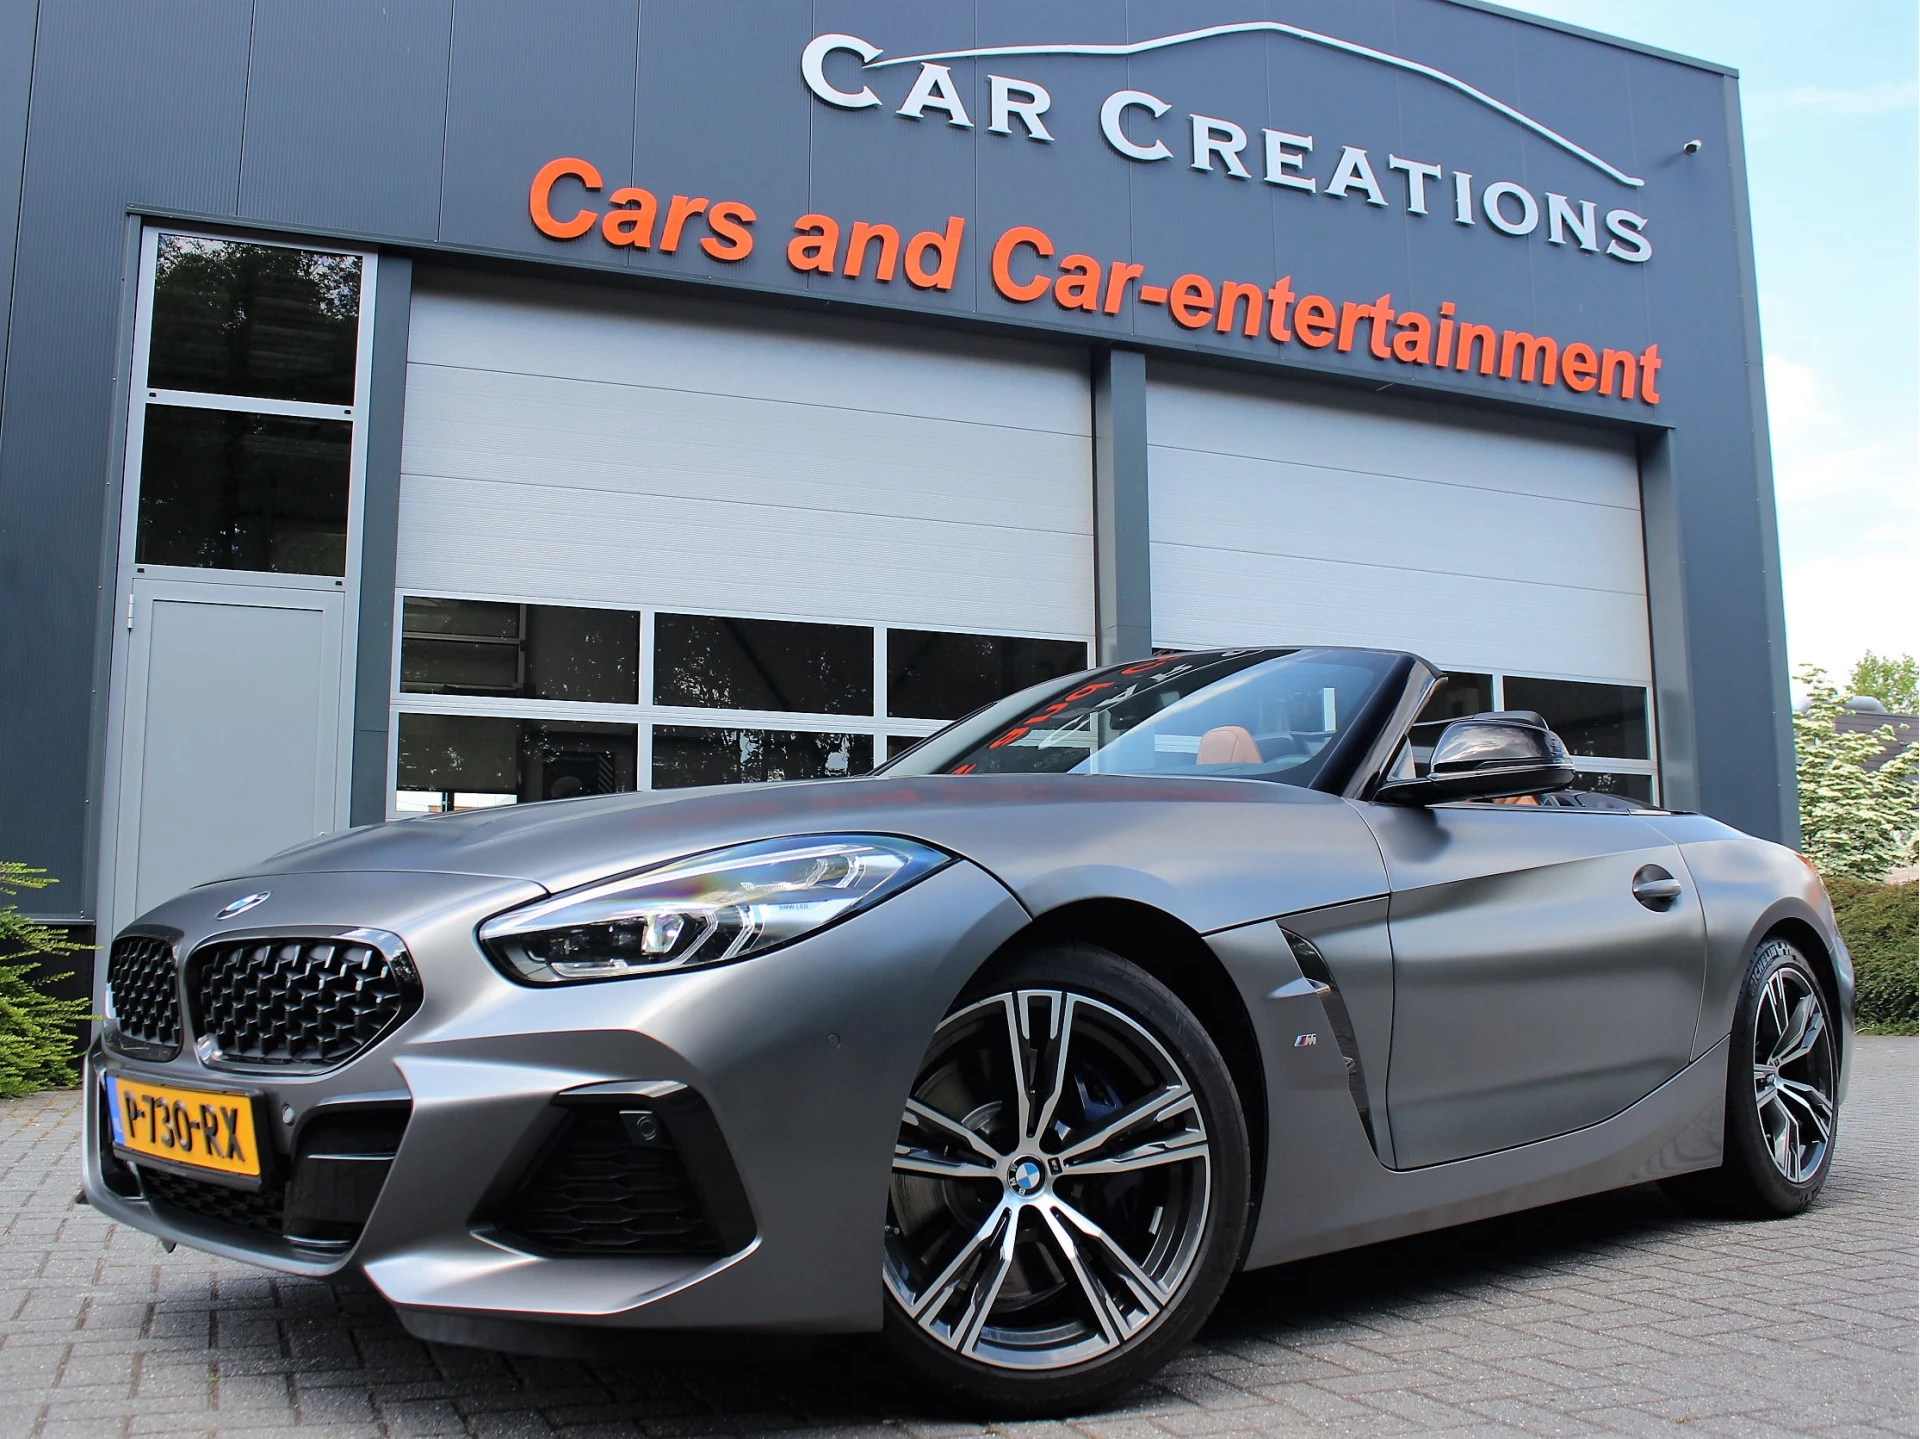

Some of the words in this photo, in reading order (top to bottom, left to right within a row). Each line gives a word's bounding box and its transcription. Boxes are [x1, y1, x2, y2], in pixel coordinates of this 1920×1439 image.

[801, 33, 1055, 142] CAR
[1100, 90, 1654, 263] CREATIONS
[529, 157, 757, 261] Cars
[787, 214, 965, 290] and
[992, 226, 1661, 404] Car-entertainment
[124, 1090, 245, 1162] P-730-RX
